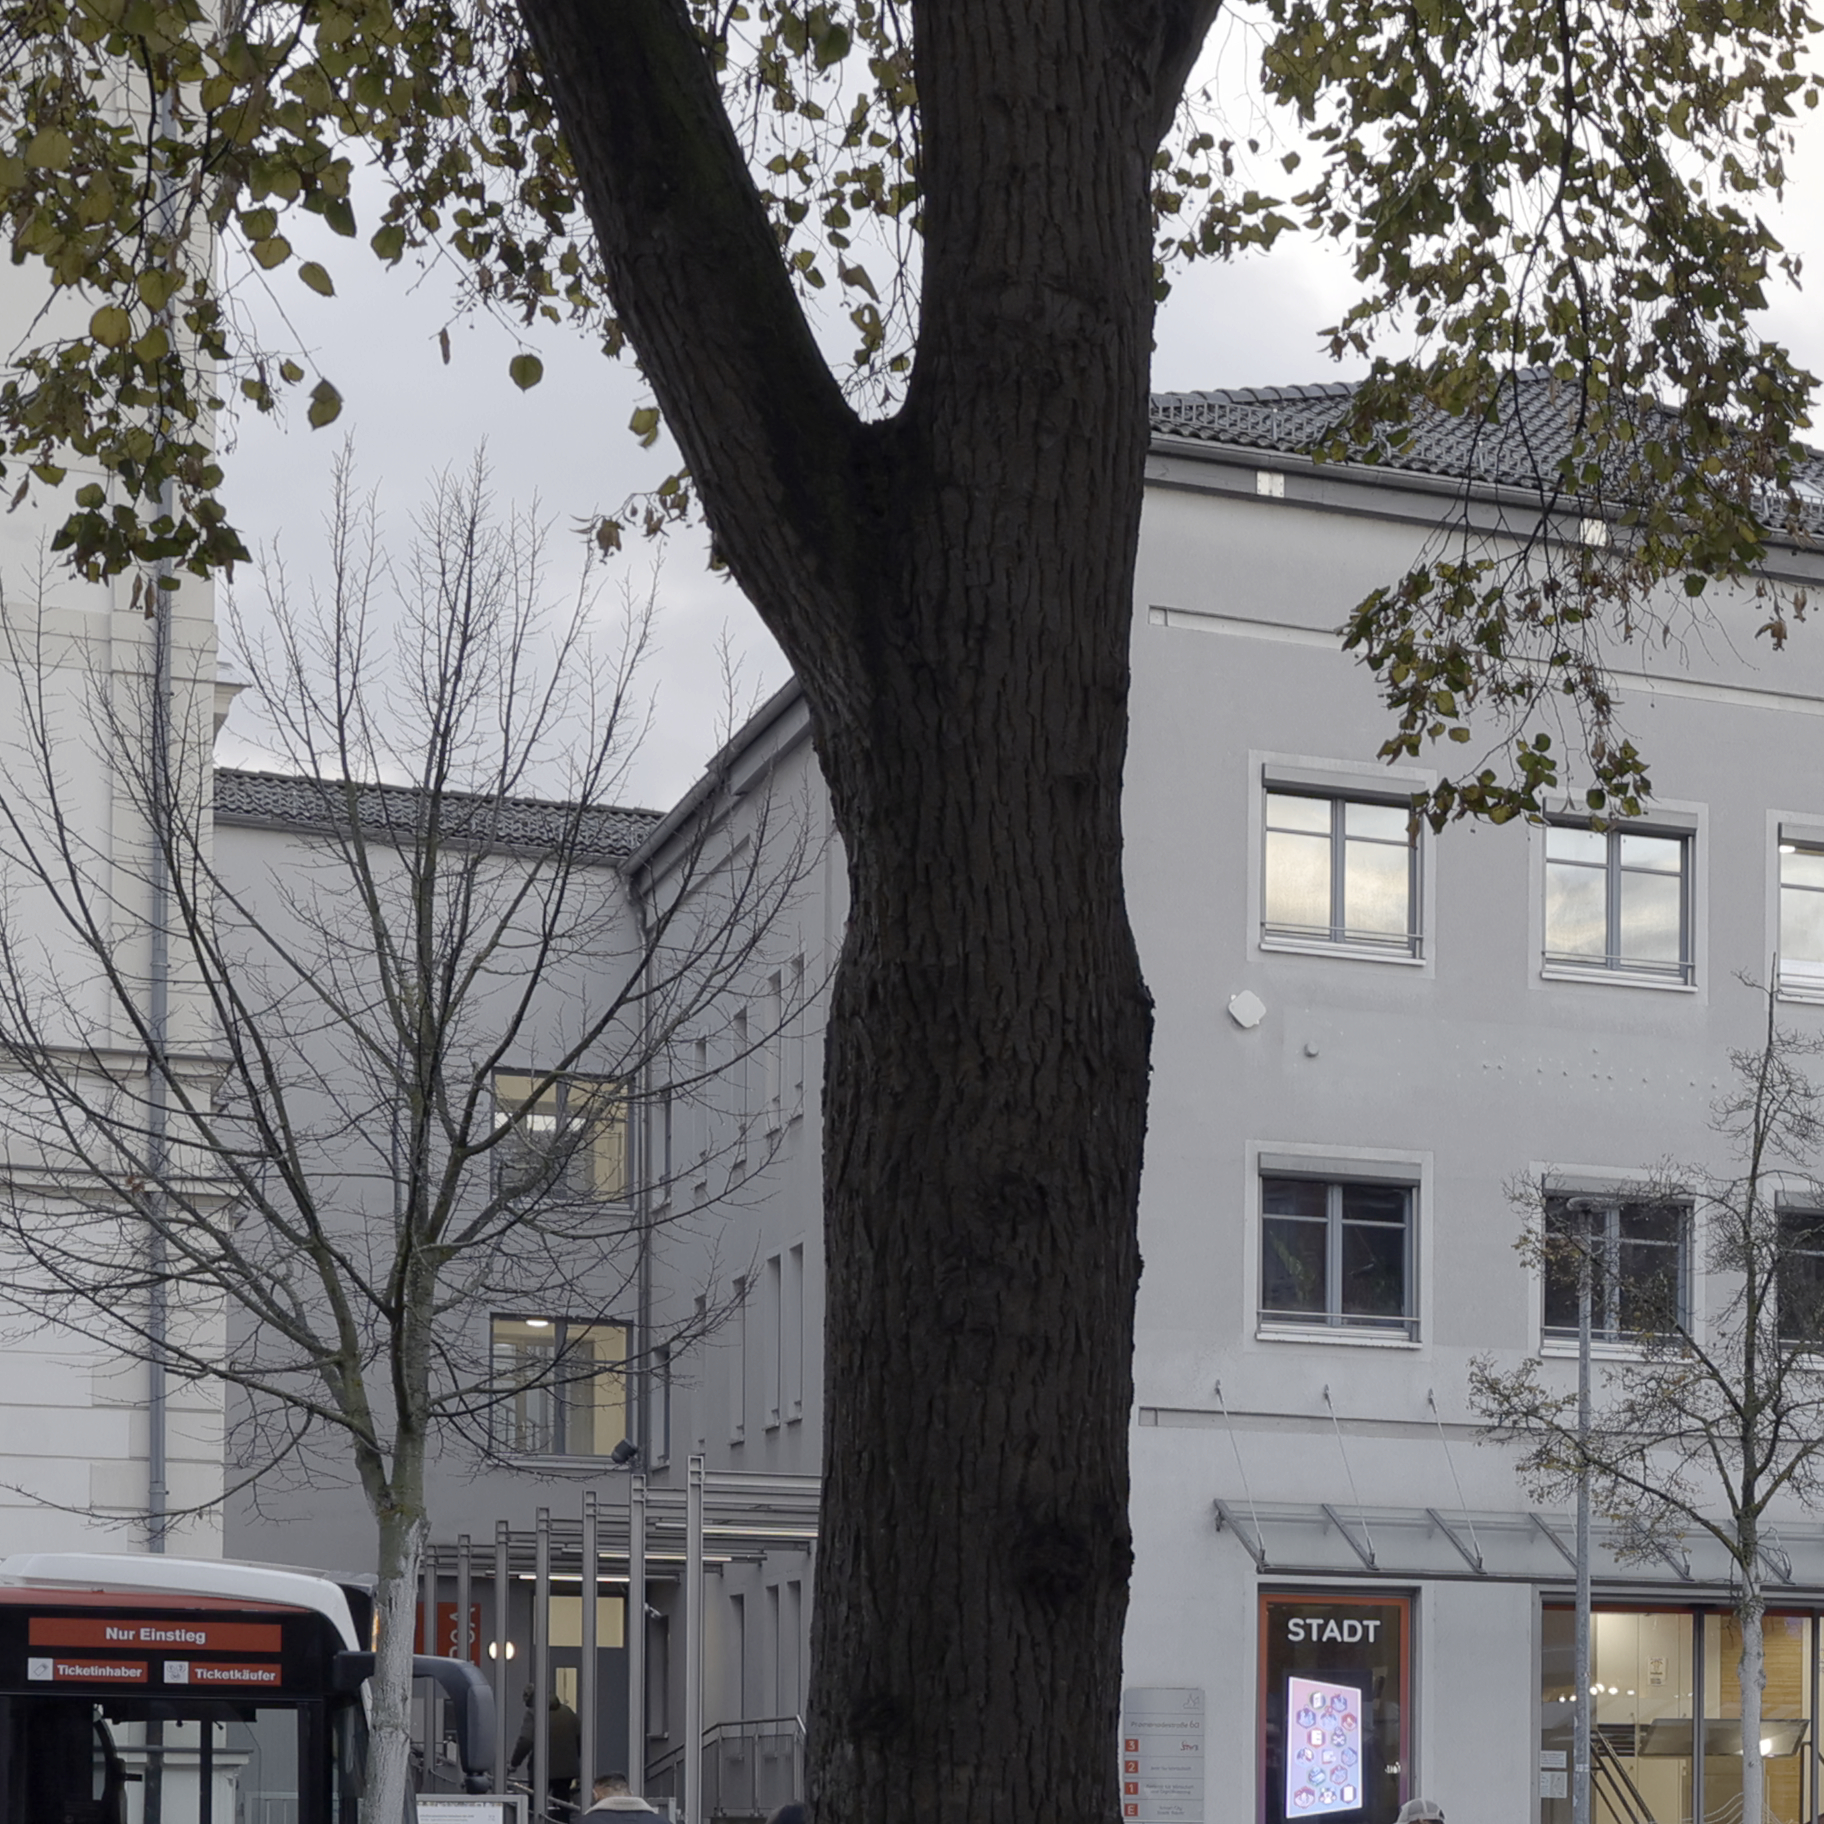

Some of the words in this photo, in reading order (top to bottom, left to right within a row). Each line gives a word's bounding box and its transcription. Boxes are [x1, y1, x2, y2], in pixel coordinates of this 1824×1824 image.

[105, 1627, 136, 1641] Nur
[140, 1627, 207, 1645] Einstieg
[1287, 1617, 1381, 1643] STADT
[57, 1664, 142, 1678] Ticketinhaber
[195, 1667, 276, 1681] Ticketkäufer
[1189, 1720, 1200, 1728] 6a
[1127, 1740, 1136, 1751] 3
[1127, 1761, 1136, 1772] 2
[1127, 1805, 1135, 1815] E
